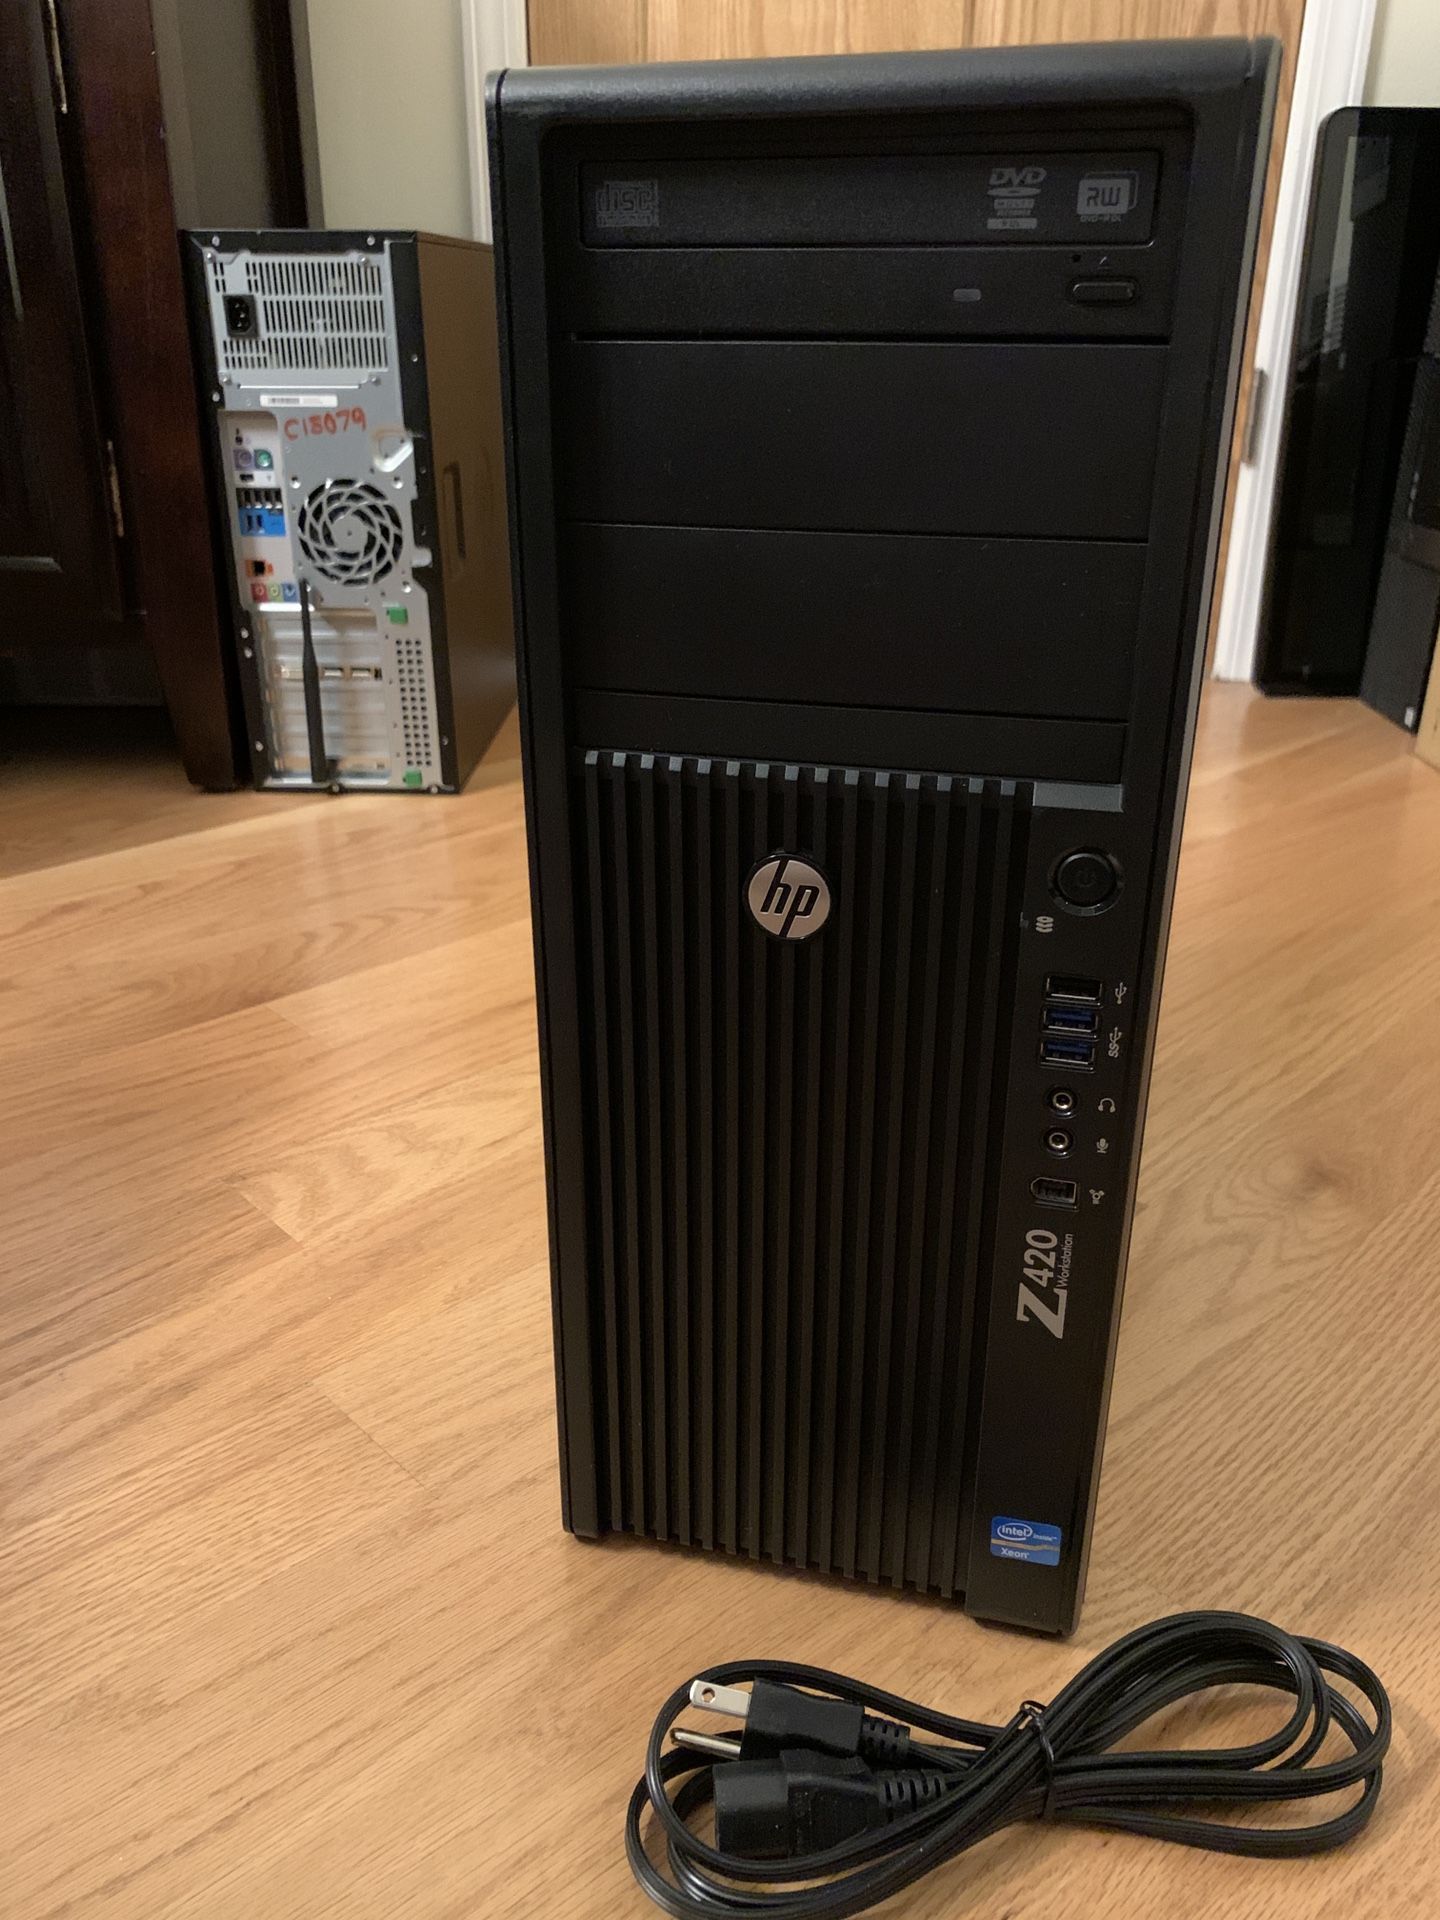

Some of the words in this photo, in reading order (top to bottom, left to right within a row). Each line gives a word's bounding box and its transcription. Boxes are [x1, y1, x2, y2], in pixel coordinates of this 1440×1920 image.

[988, 167, 1047, 187] DVD
[1087, 187, 1121, 206] RW
[760, 859, 820, 938] hp
[1056, 1233, 1073, 1288] Workstation
[1016, 1229, 1067, 1339] Z420
[1001, 1547, 1028, 1559] Xeon
